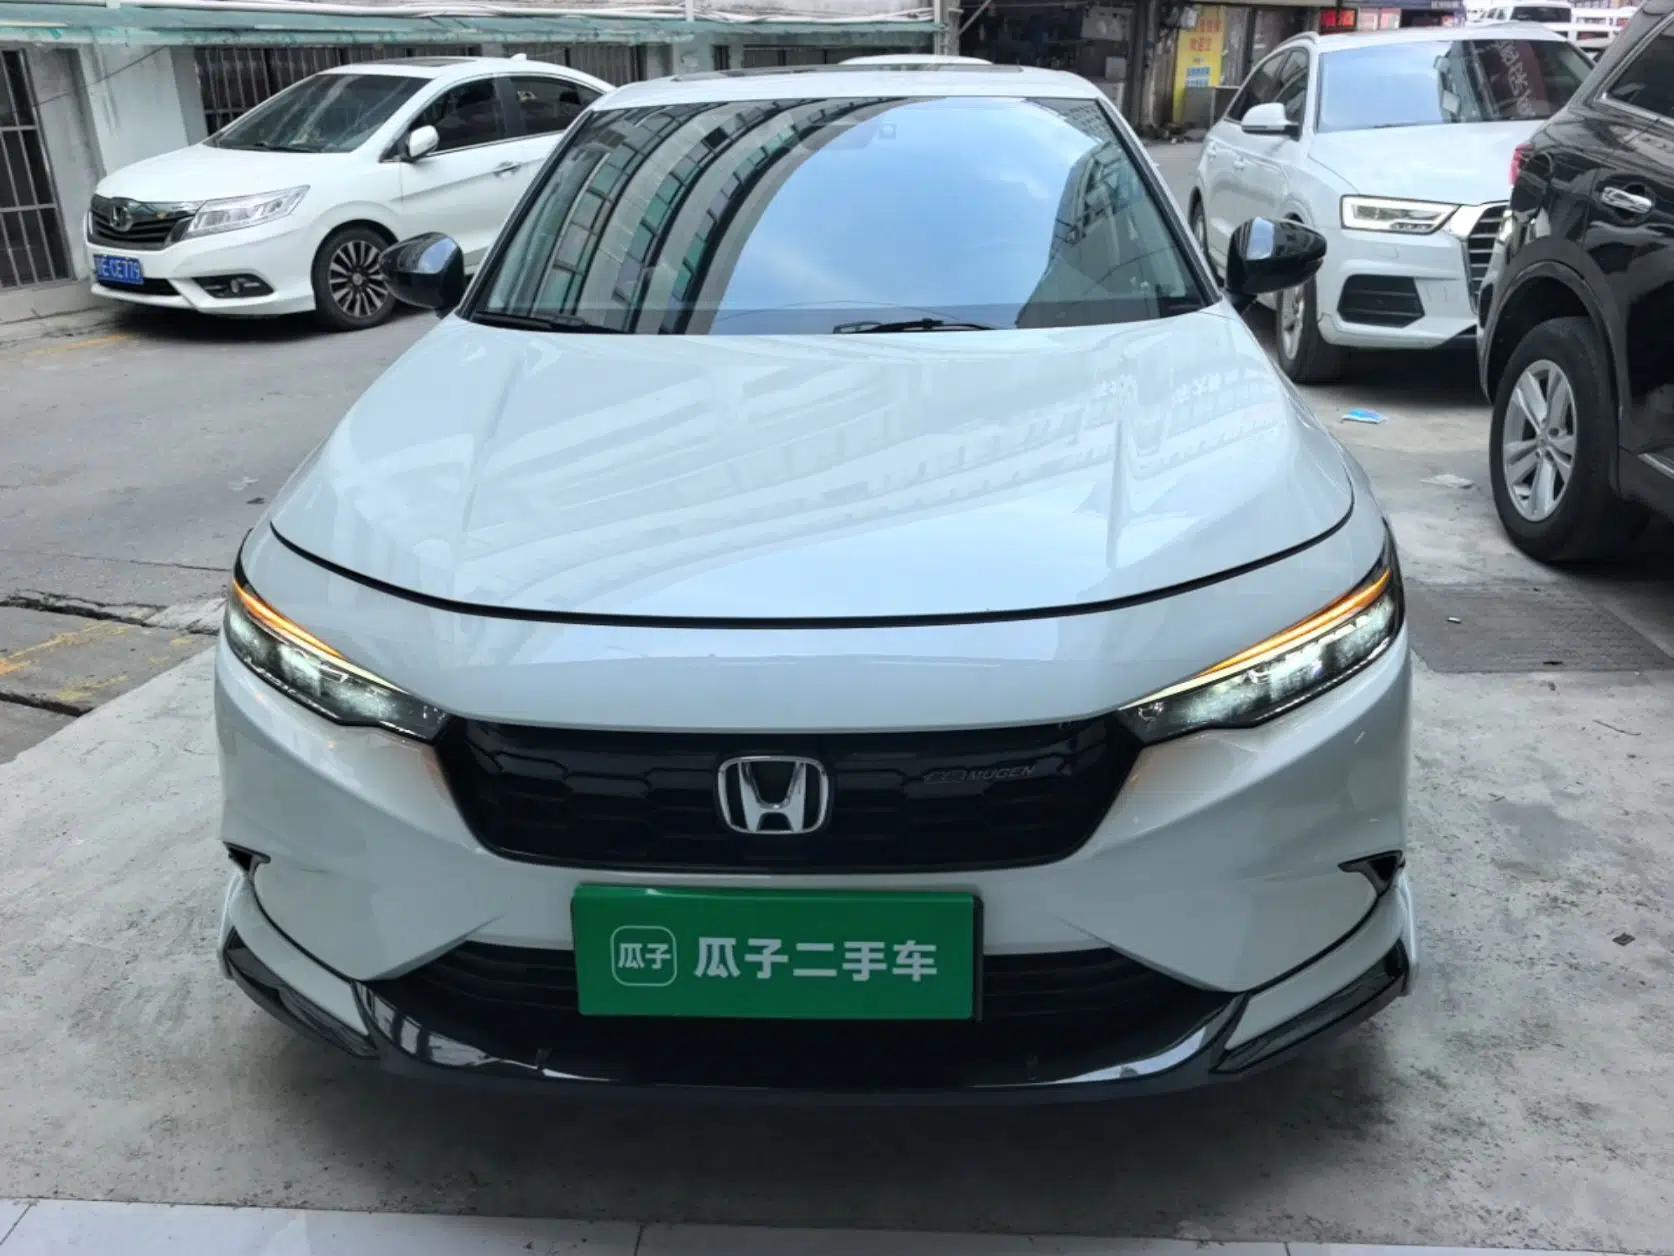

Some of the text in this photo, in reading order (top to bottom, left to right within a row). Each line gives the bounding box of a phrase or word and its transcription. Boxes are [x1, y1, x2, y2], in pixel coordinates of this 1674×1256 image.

[967, 765, 1037, 781] MUGEN
[618, 943, 671, 969] 瓜子
[693, 937, 937, 982] 瓜子二手车
